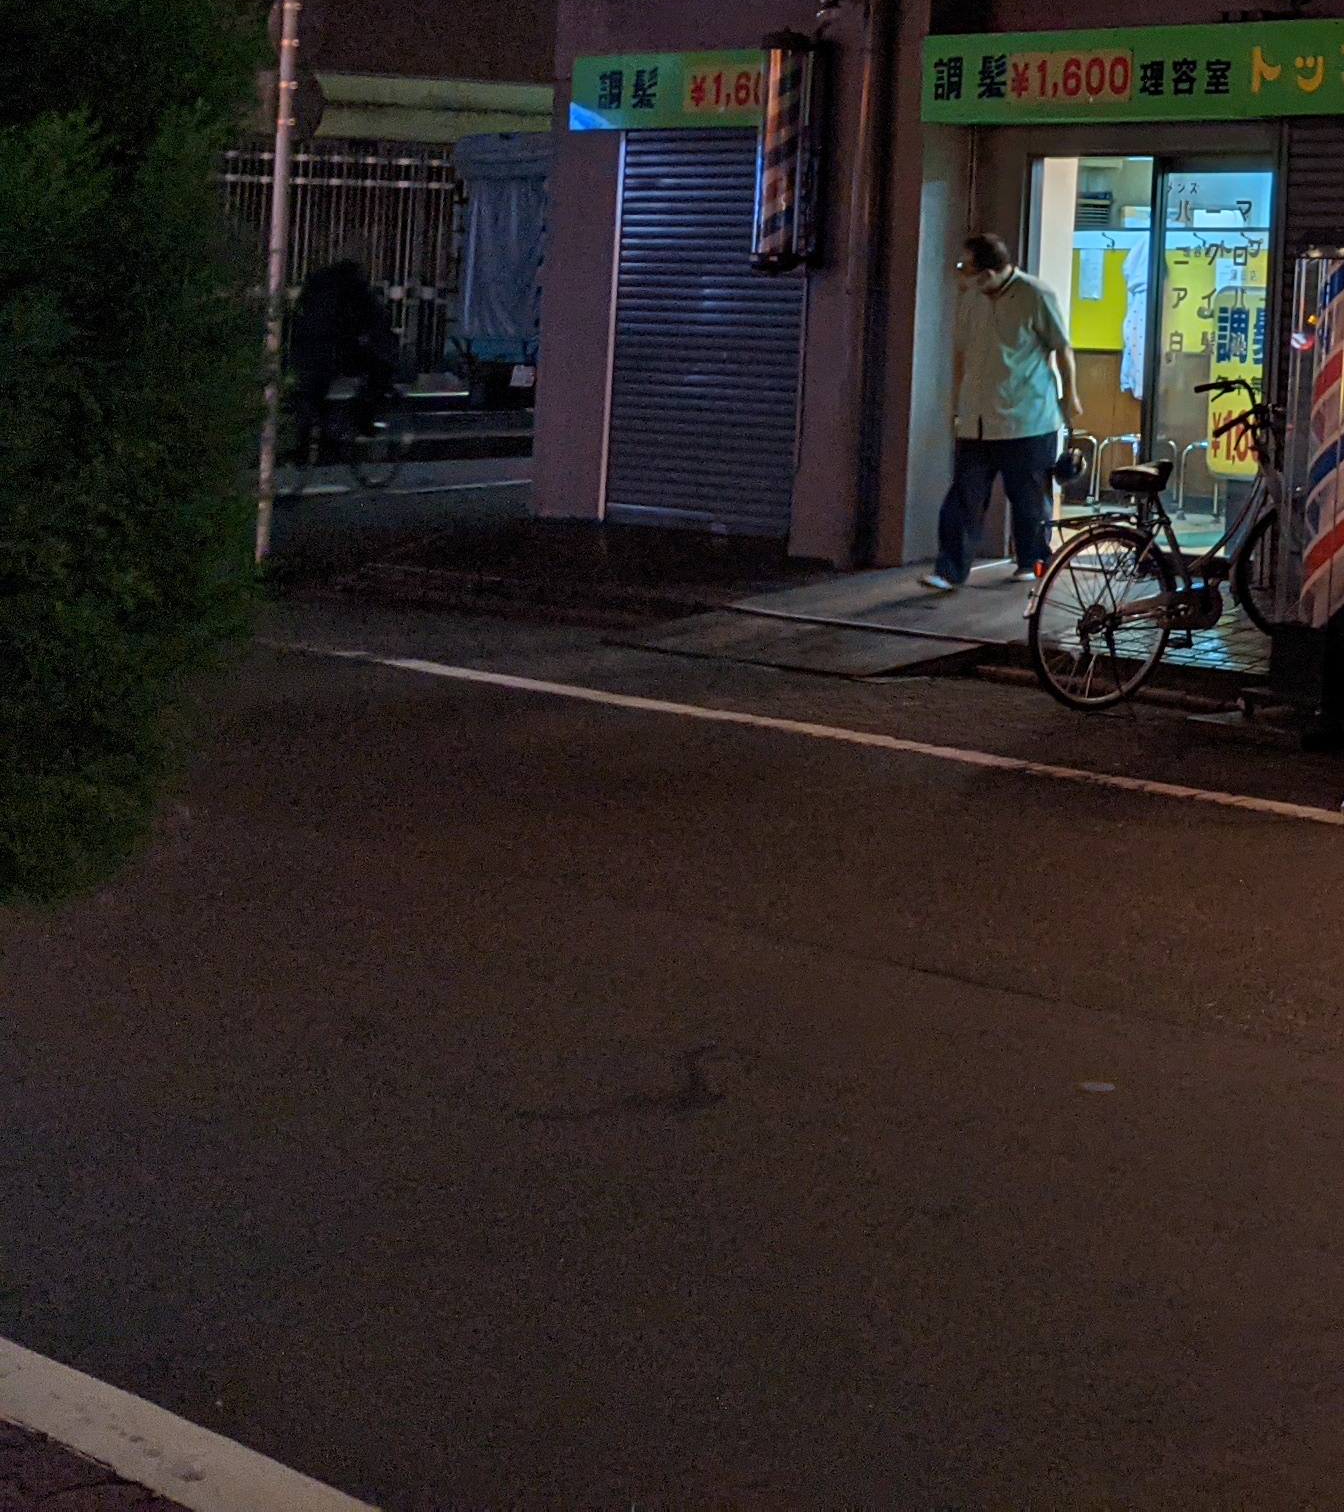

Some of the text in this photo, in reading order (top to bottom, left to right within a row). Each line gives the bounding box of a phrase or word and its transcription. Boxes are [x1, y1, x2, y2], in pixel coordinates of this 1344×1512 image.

[932, 54, 1007, 102] 調髪
[1009, 56, 1132, 98] ¥1,600
[1139, 58, 1233, 97] 理容室
